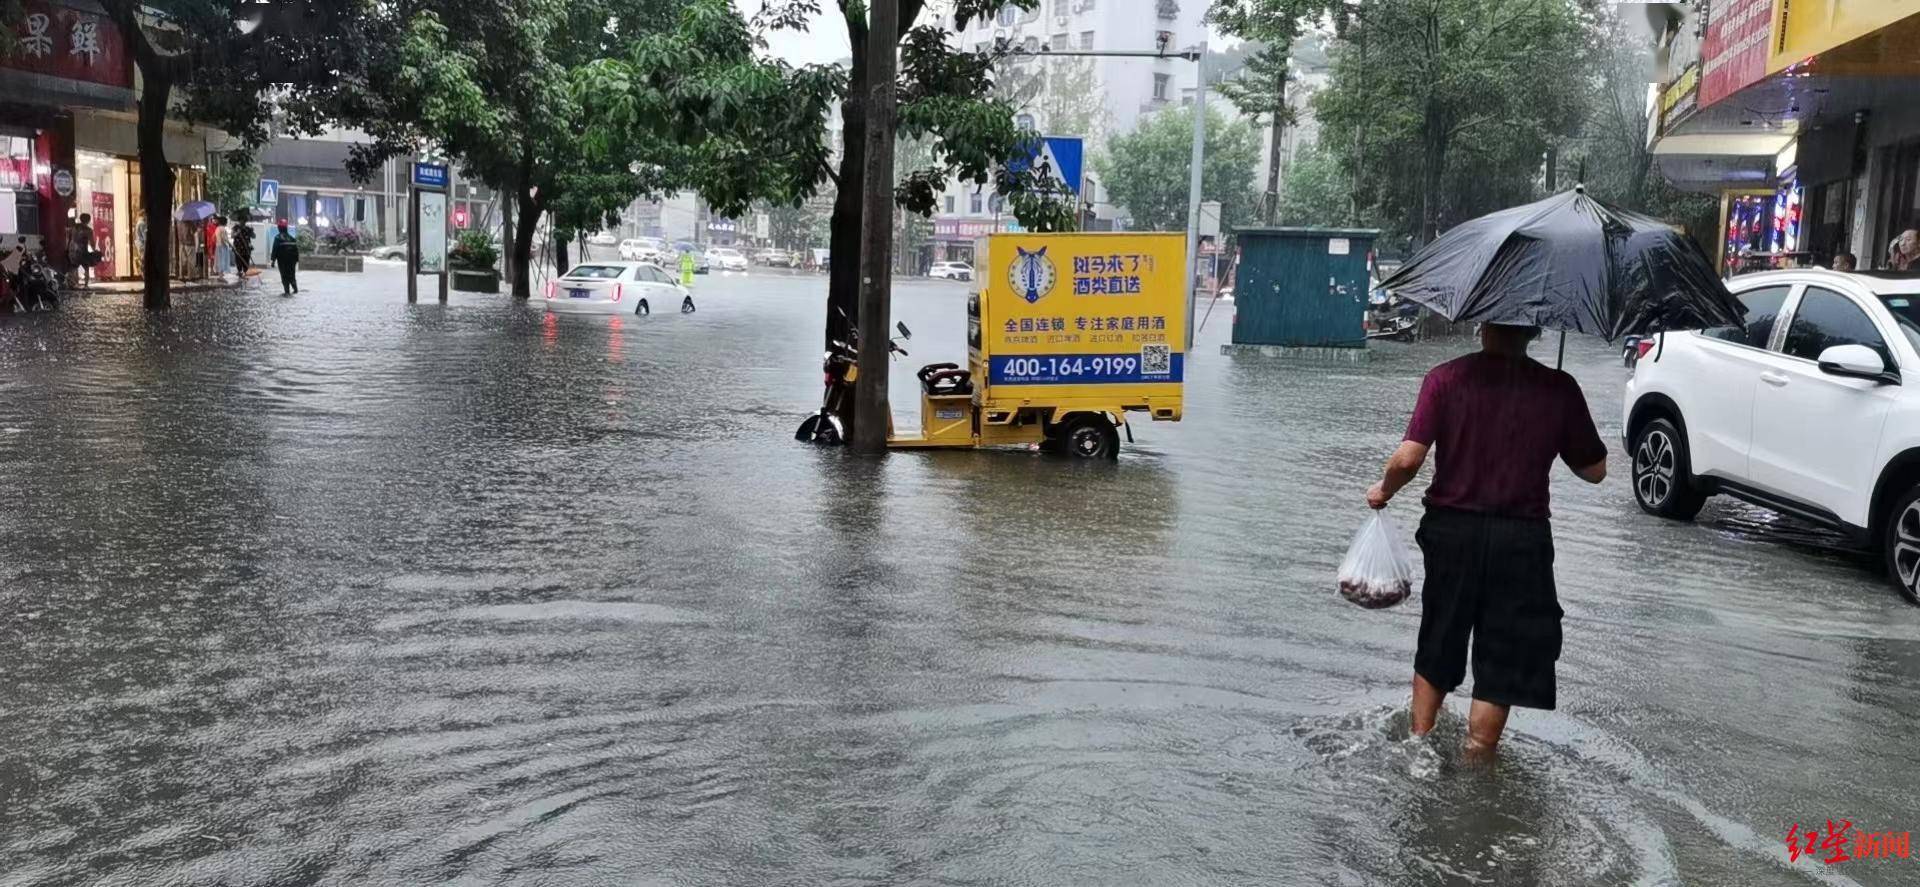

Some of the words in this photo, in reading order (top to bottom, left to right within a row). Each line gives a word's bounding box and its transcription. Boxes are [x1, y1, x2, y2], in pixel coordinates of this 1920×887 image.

[1073, 254, 1140, 274] 斑马来了
[1073, 276, 1140, 295] 酒类直送
[1004, 317, 1065, 332] 全国连锁
[1074, 316, 1166, 331] 专注家庭用酒
[1003, 357, 1137, 376] 400-164-9199
